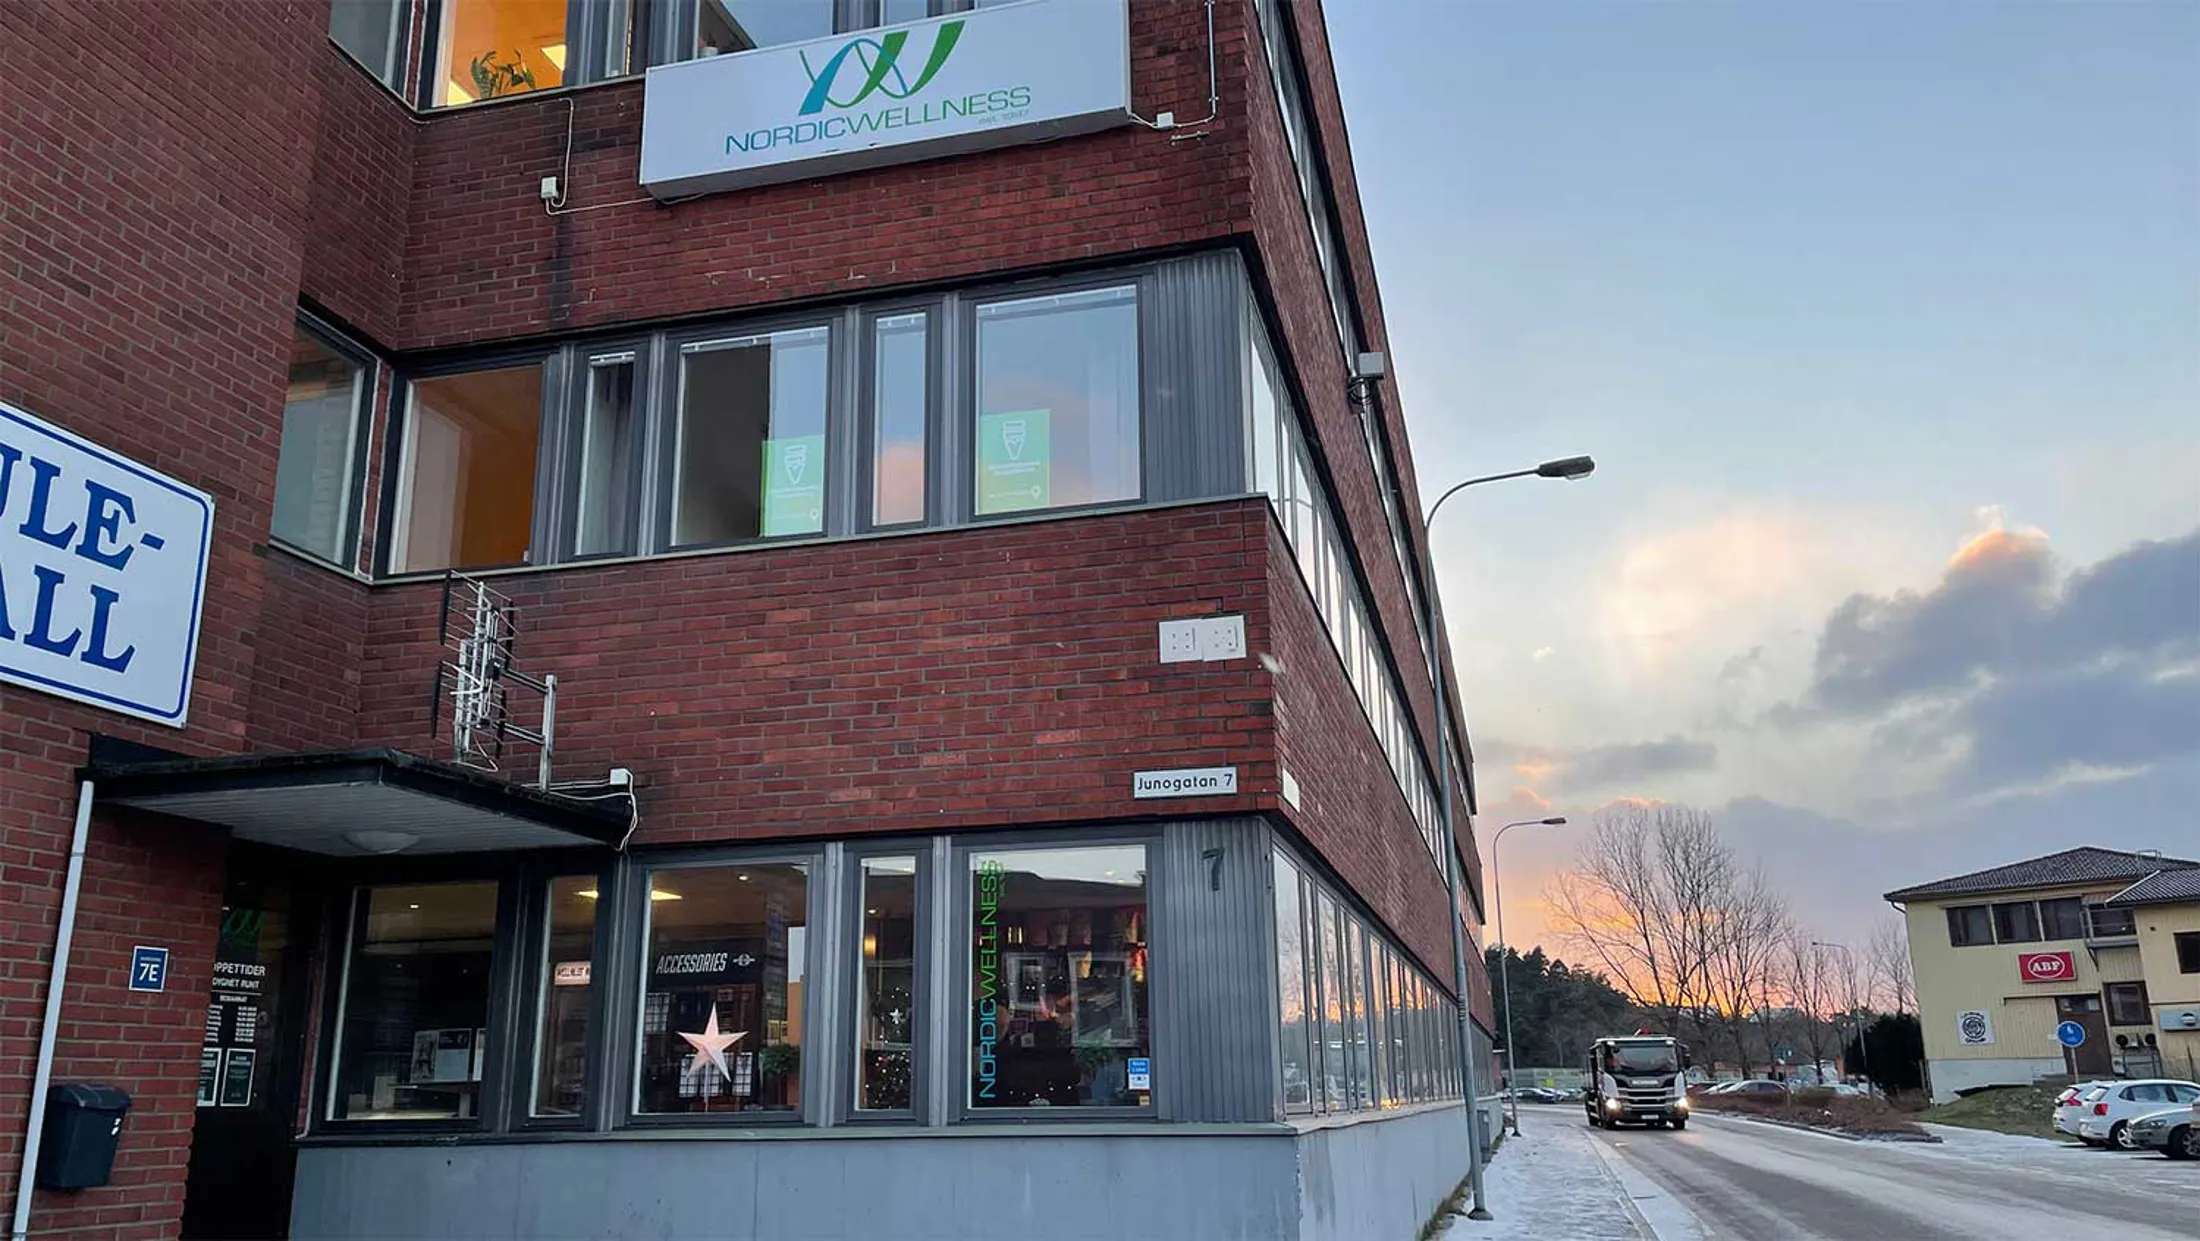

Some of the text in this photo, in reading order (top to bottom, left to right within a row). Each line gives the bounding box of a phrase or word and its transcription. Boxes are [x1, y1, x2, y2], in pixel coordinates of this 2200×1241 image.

[725, 86, 1031, 155] NORDICWELLNESS
[0, 560, 136, 674] LL
[1137, 774, 1233, 792] Junogatan 7
[1202, 848, 1225, 892] 7
[139, 962, 160, 982] 7E
[656, 952, 728, 974] ACCESSORIES
[979, 859, 998, 1099] NORDICWELLNESS
[2032, 961, 2061, 972] ABP
